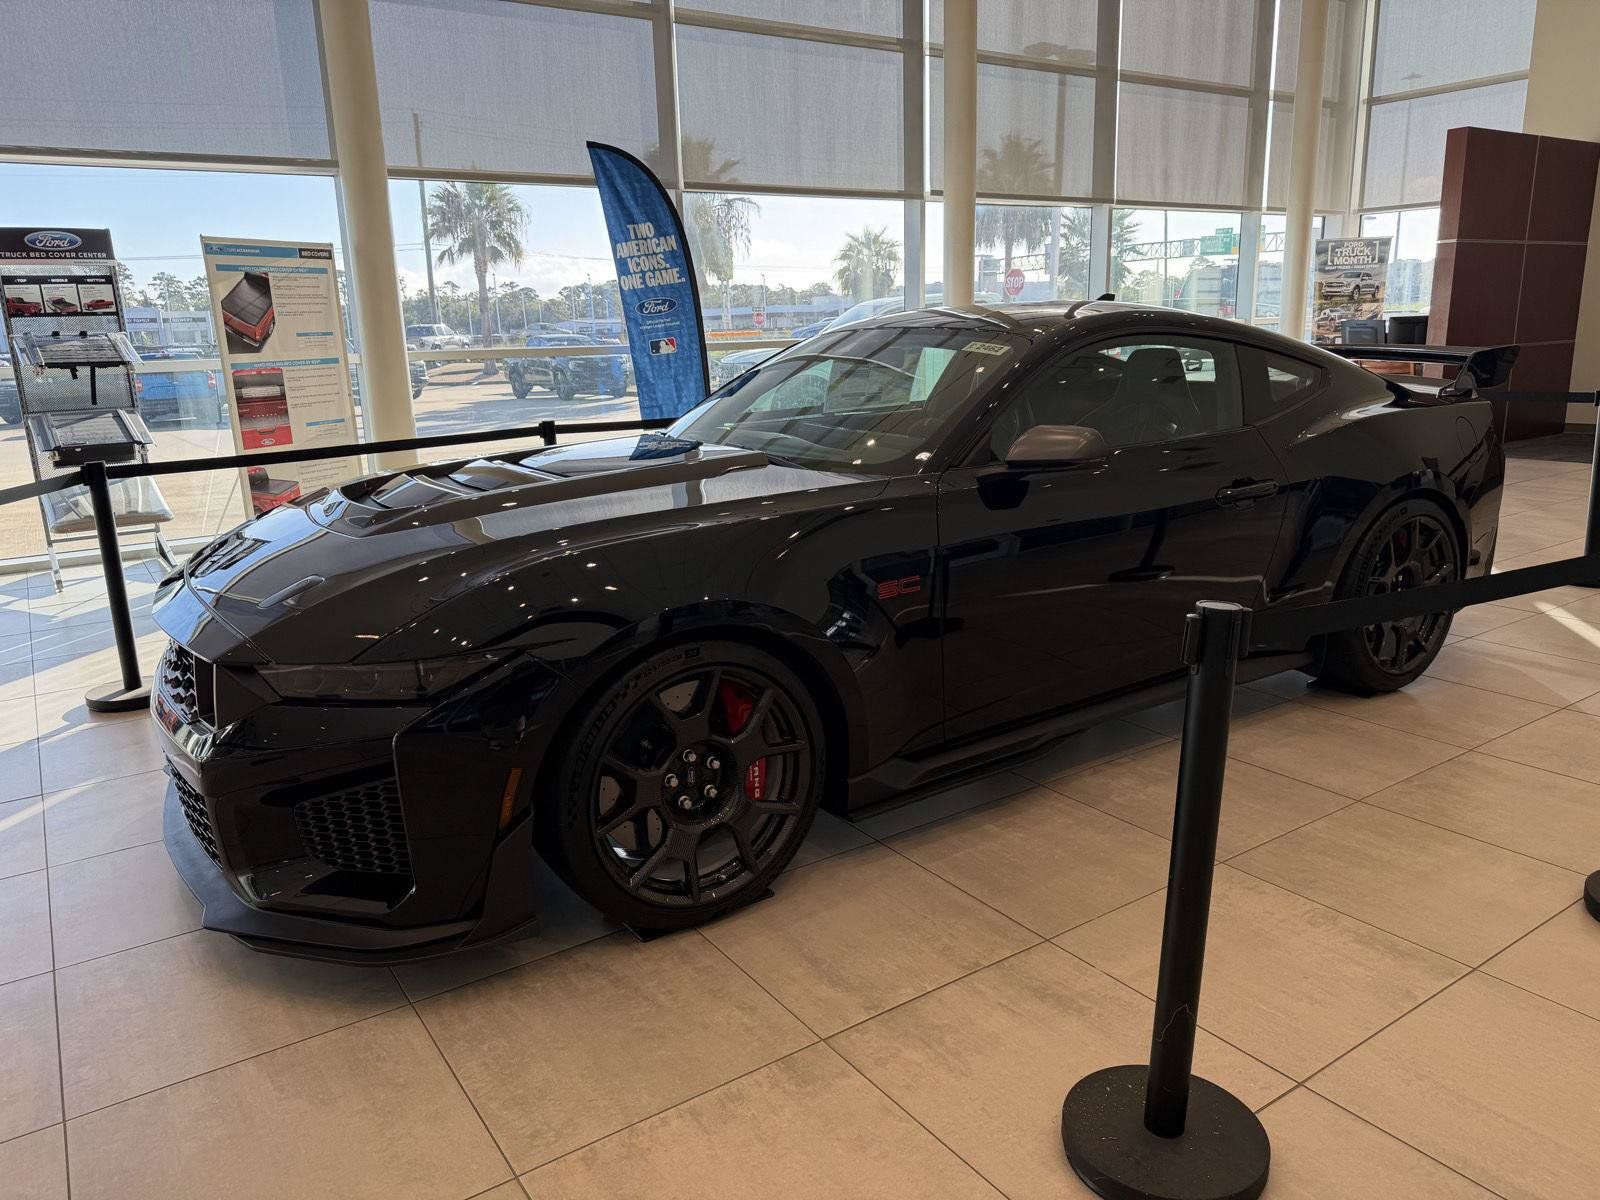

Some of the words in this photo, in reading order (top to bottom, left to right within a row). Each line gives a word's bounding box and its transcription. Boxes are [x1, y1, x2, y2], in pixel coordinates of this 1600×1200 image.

[627, 222, 655, 239] TWO
[36, 234, 70, 247] Ford
[616, 235, 677, 259] AMERICAN
[1335, 247, 1370, 256] TRUCK
[628, 254, 670, 273] ICONS.
[1334, 256, 1372, 265] MONTH
[620, 273, 644, 290] ONE
[1006, 276, 1023, 288] STOP
[642, 300, 669, 313] Ford
